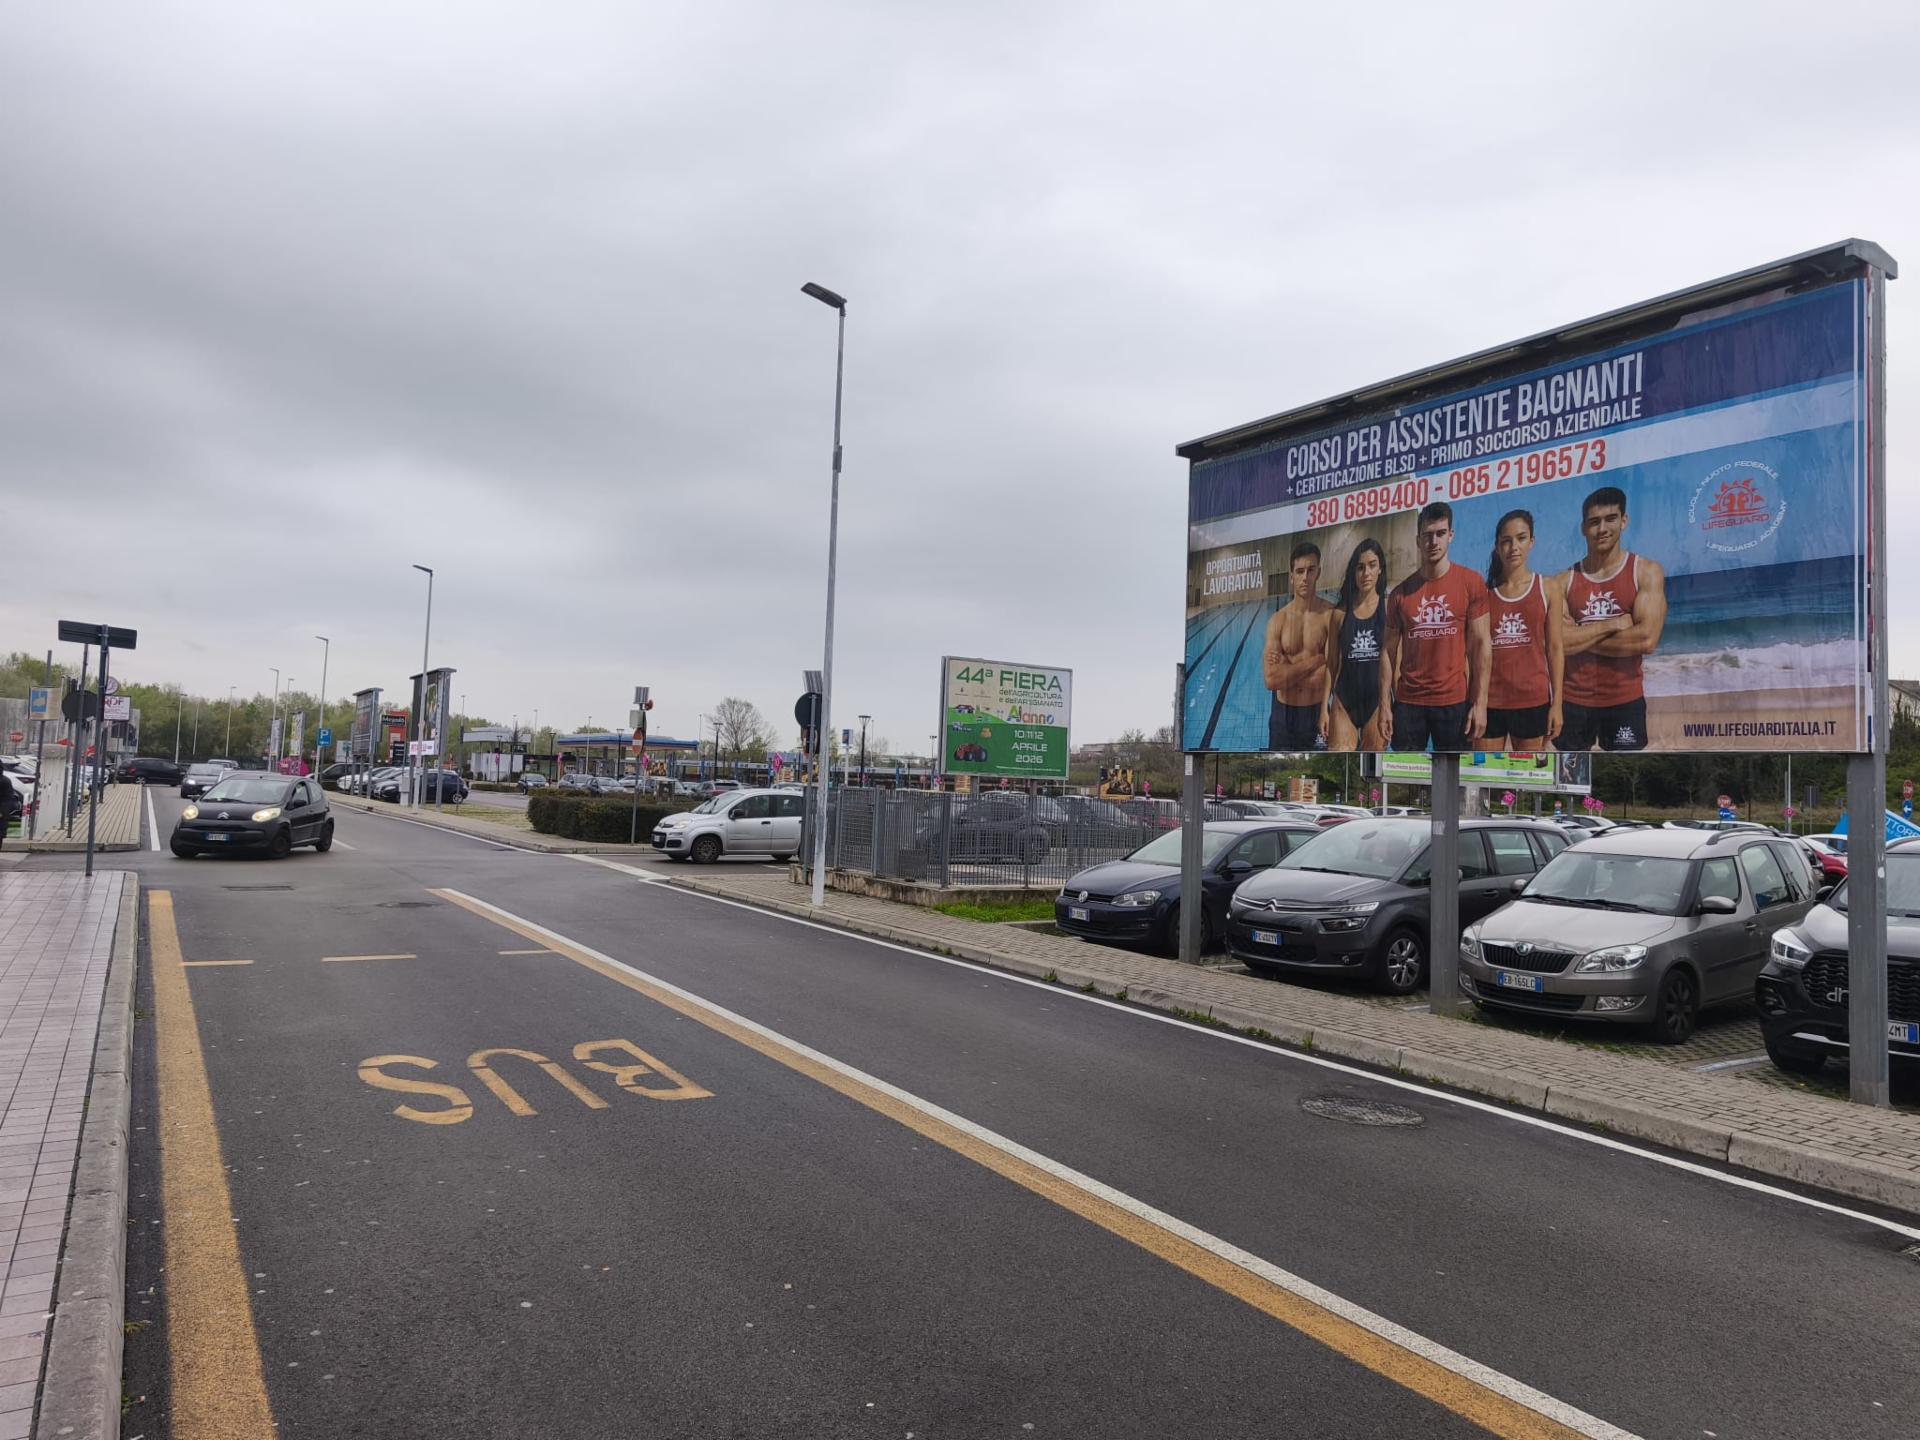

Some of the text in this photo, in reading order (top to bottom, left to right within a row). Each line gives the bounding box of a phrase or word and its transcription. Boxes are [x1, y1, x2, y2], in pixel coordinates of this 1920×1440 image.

[1286, 352, 1643, 480] CORSO PER ASSISTENTE BAGNANTI
[1295, 461, 1382, 497] CERTIFICAZIONE
[1384, 453, 1416, 476] BLSD
[1430, 439, 1472, 466] PRIMO
[1475, 420, 1551, 456] SOCCORSO
[1554, 396, 1642, 438] AZIENDALE
[1306, 497, 1339, 528] 380
[1343, 478, 1430, 520] 6899400
[1449, 464, 1490, 499] 085
[1496, 439, 1606, 490] 2196573
[1688, 460, 1780, 524] SCUOLA NUOTO FEDERALE
[1702, 513, 1770, 531] LIFEGUARD
[1760, 499, 1787, 542] ACADEMY
[1206, 549, 1262, 576] OPPORTUNITÀ
[1203, 570, 1263, 596] LAVORATIVA
[1408, 626, 1458, 639] LIFEGUARD
[1347, 651, 1380, 659] LIFEGUARD
[999, 670, 1063, 693] FIERA
[1007, 704, 1055, 725] Alanno
[320, 729, 329, 739] P
[1683, 720, 1837, 738] WWW.LIFEGUARDITALIA.IT
[1011, 741, 1048, 752] APRILE
[1015, 754, 1044, 764] 2026
[357, 1038, 717, 1126] BUS
